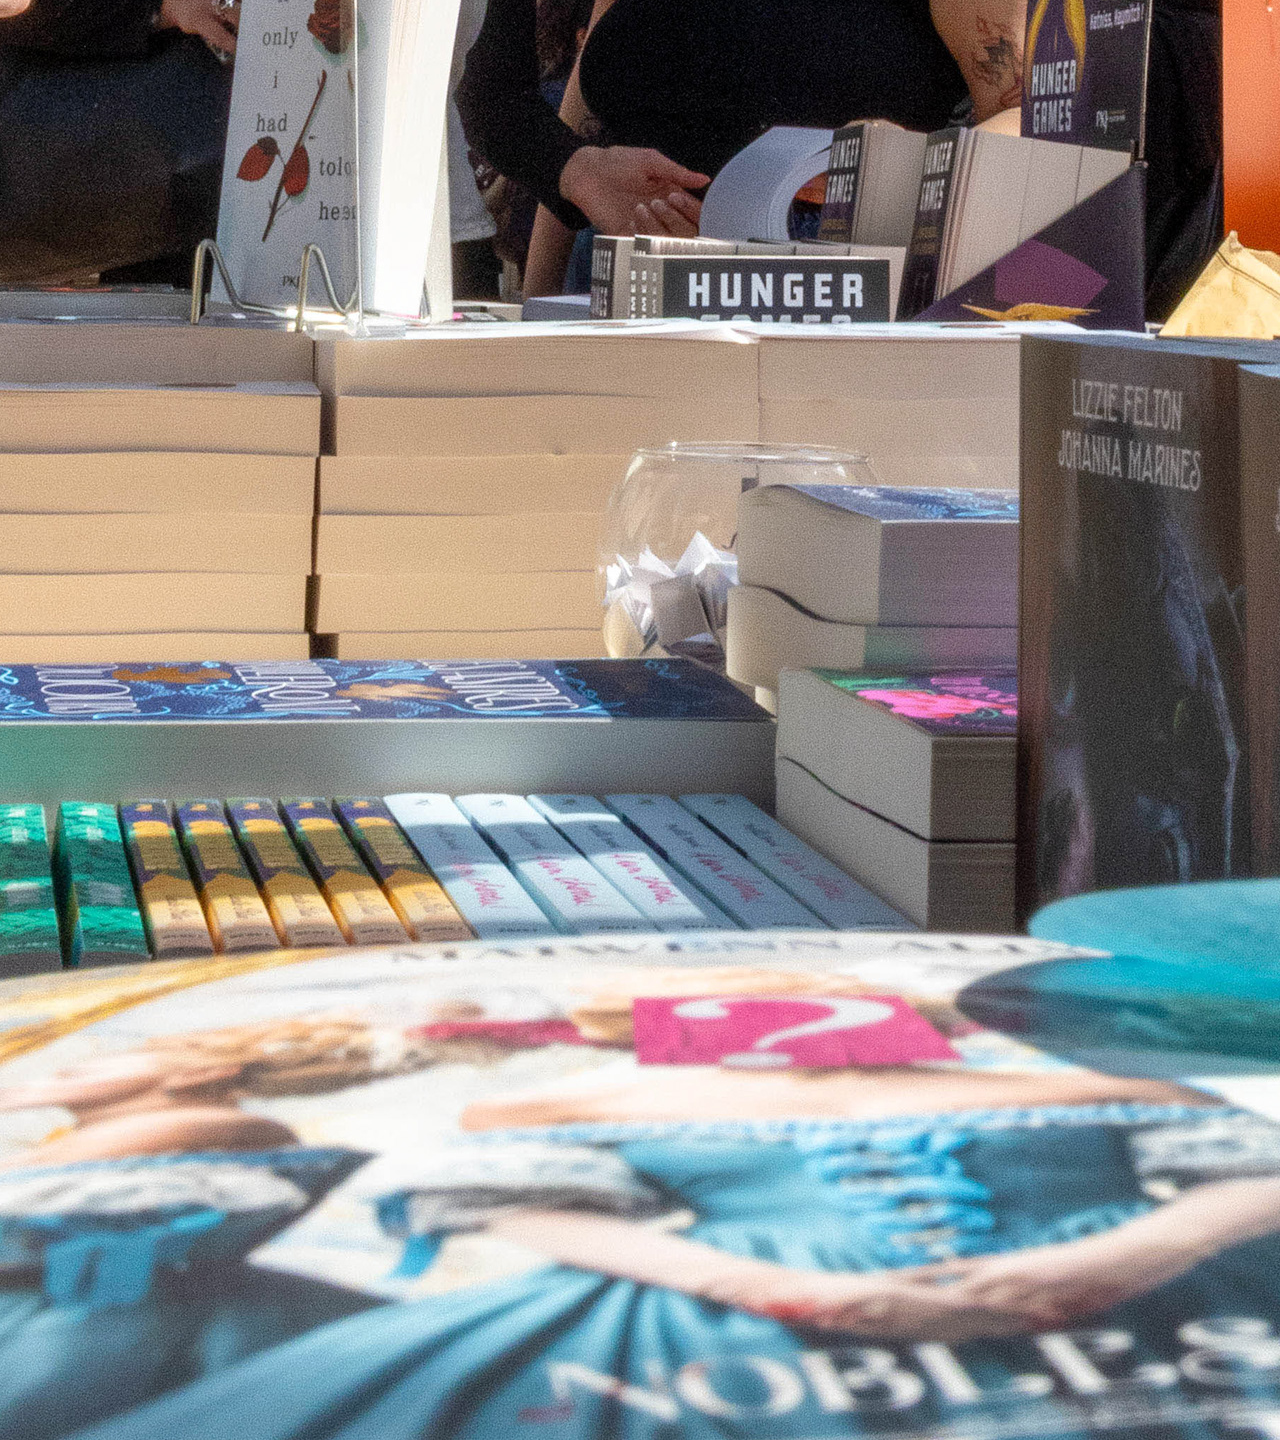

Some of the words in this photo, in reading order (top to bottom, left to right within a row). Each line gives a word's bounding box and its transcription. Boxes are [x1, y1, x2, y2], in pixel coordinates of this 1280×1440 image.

[262, 27, 299, 49] only
[1031, 59, 1077, 97] HUNGER
[255, 113, 289, 133] had
[1033, 98, 1073, 134] GAMES
[688, 272, 864, 308] HUNGER
[1071, 378, 1119, 424] LIZZIE
[1122, 384, 1183, 433] FELTON
[1058, 430, 1122, 478] JOHANNA
[1128, 436, 1203, 493] MARINES
